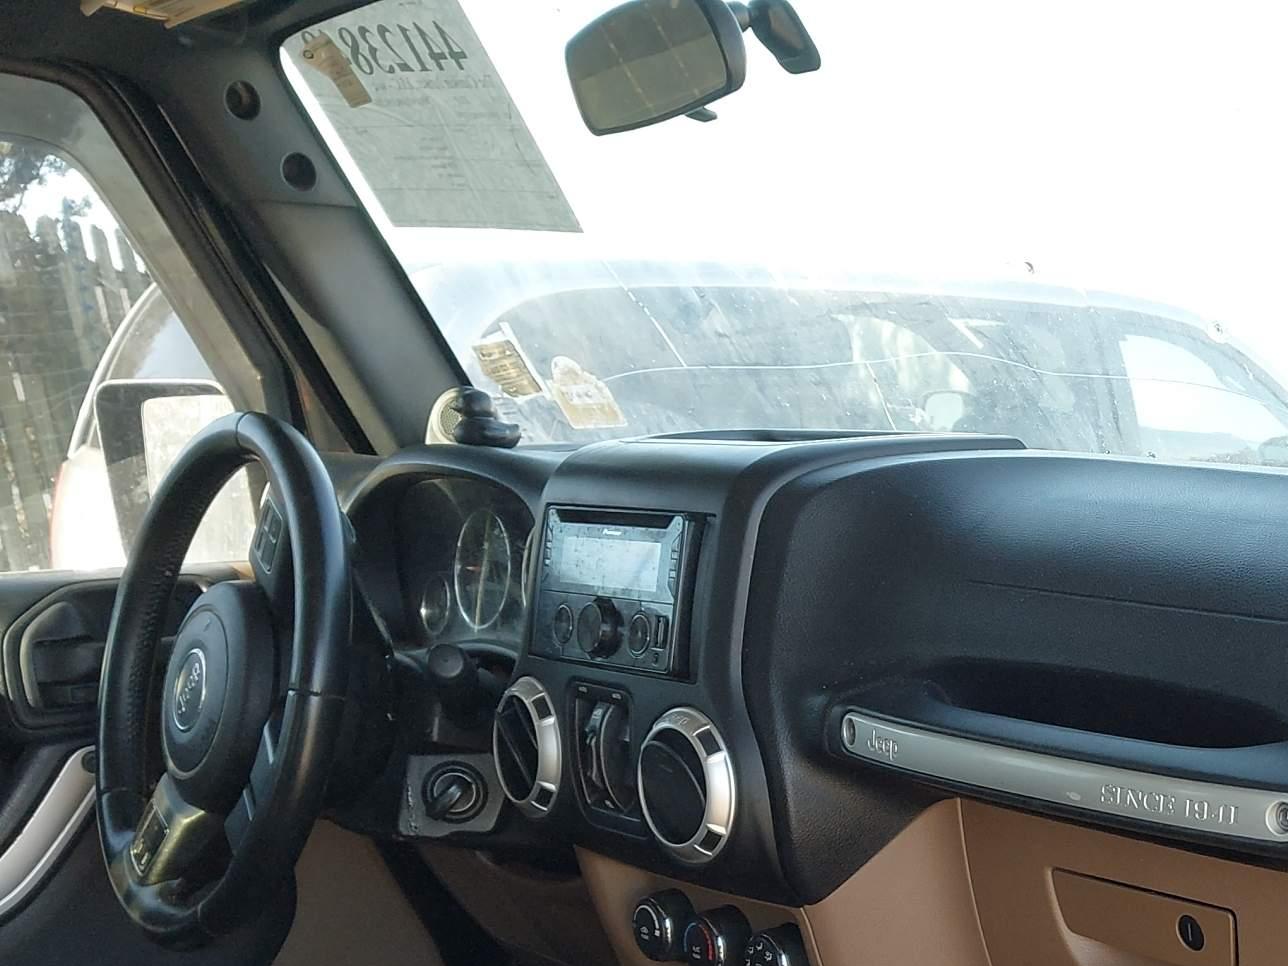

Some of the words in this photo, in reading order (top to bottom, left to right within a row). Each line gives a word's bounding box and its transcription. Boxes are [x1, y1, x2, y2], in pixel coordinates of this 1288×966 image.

[867, 728, 899, 761] Jeep
[1100, 783, 1176, 816] SINCE
[1184, 798, 1239, 825] 1941
